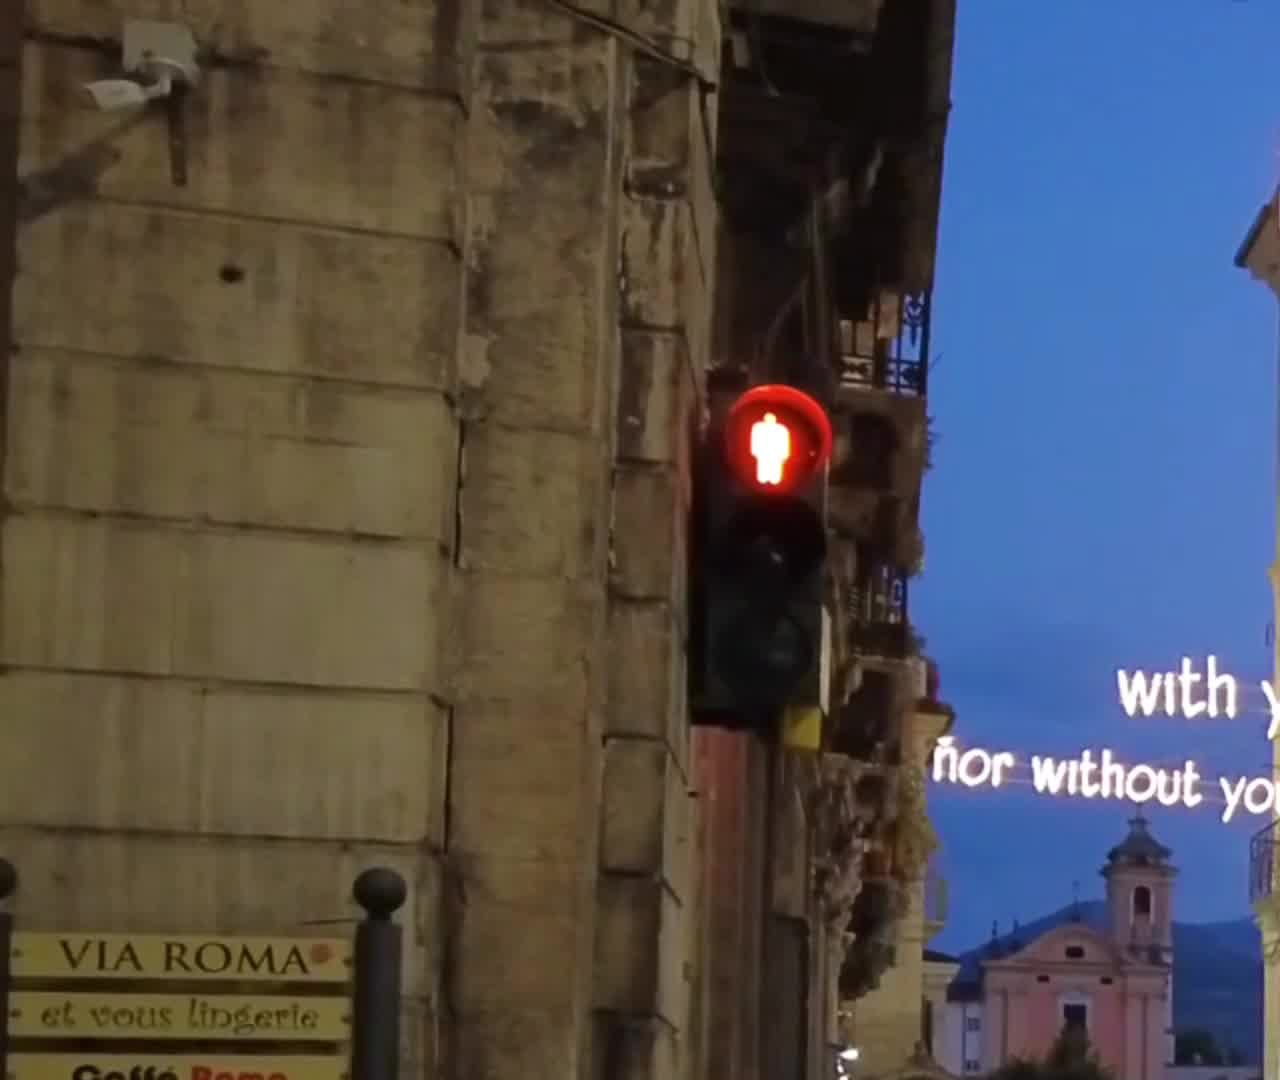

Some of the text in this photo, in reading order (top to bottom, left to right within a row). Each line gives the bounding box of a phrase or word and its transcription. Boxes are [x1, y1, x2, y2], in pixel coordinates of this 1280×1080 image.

[1117, 655, 1238, 719] with
[932, 740, 1015, 788] nor
[1030, 749, 1203, 808] without
[59, 939, 311, 975] VIA ROMA
[41, 997, 321, 1036] et vous lingerie
